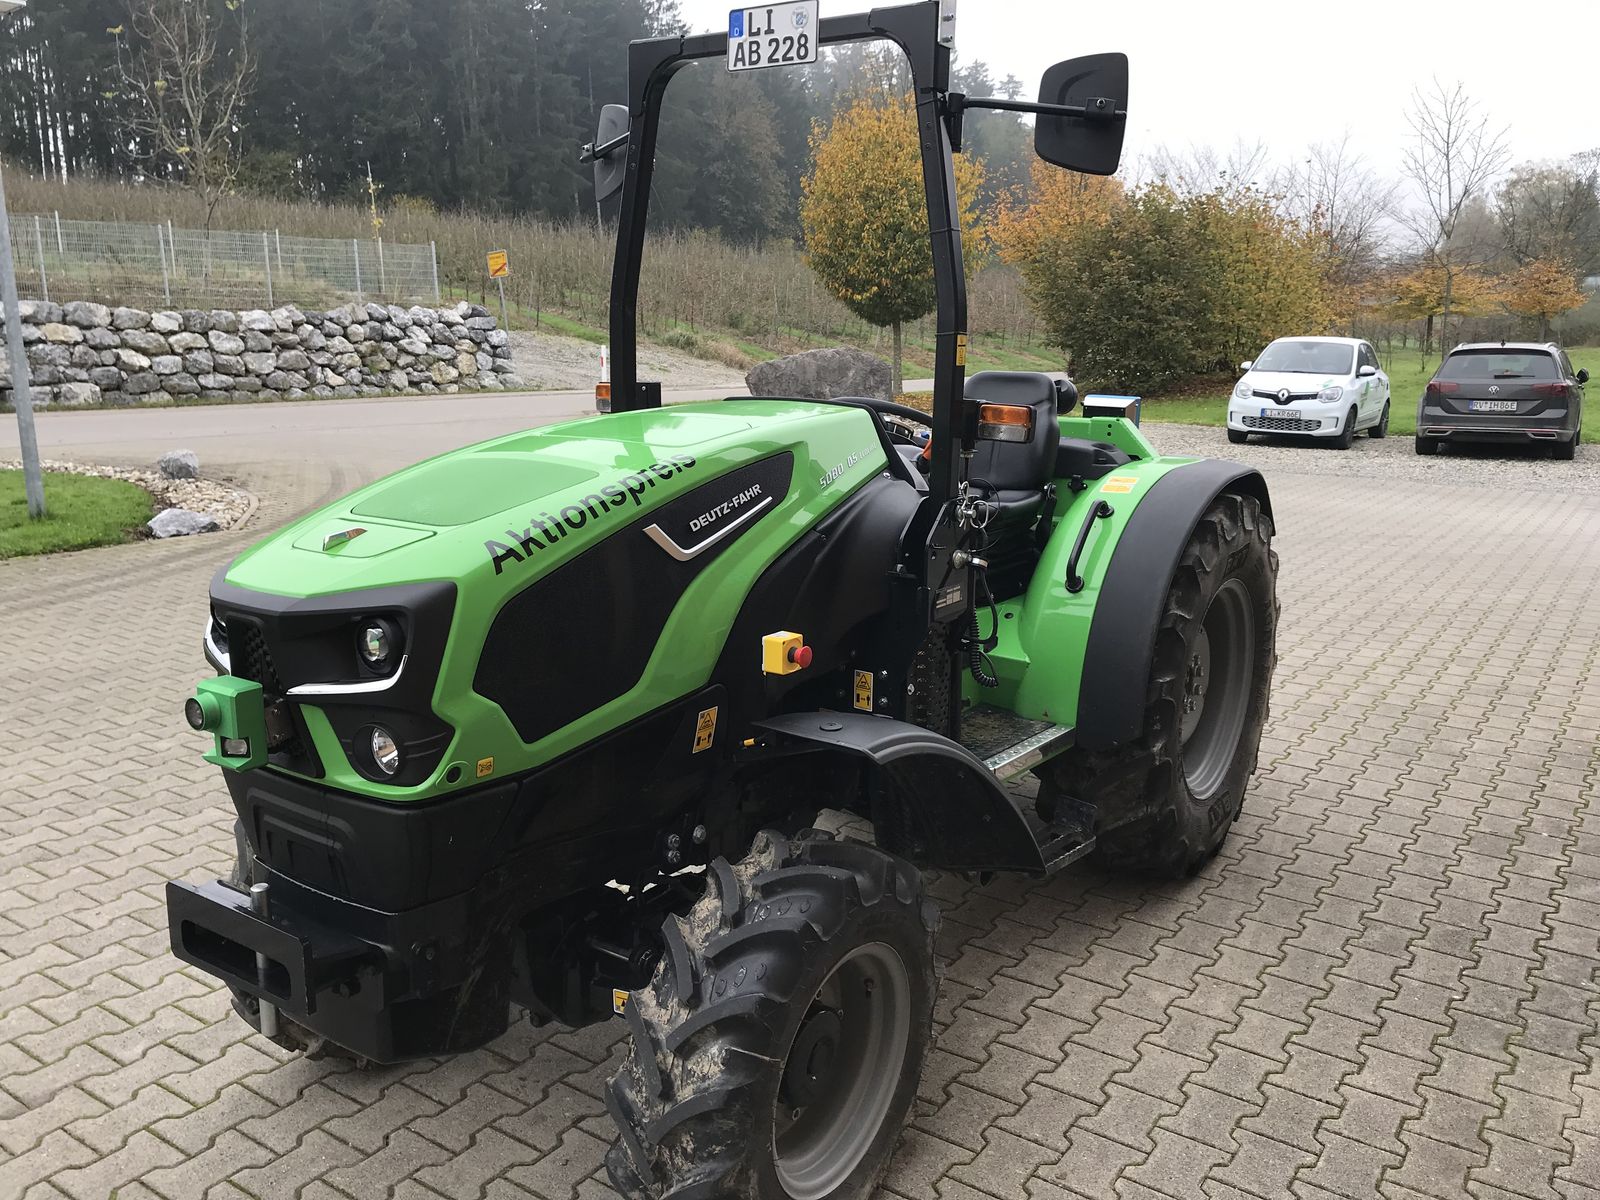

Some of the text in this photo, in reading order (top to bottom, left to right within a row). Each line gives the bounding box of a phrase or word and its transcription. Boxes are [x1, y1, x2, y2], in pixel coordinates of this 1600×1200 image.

[733, 27, 740, 36] D
[748, 9, 775, 37] LI
[733, 34, 809, 67] AB 228
[820, 463, 844, 490] 5080
[483, 453, 696, 575] Aktionspreis
[689, 483, 762, 532] DEUTZ-FAHR
